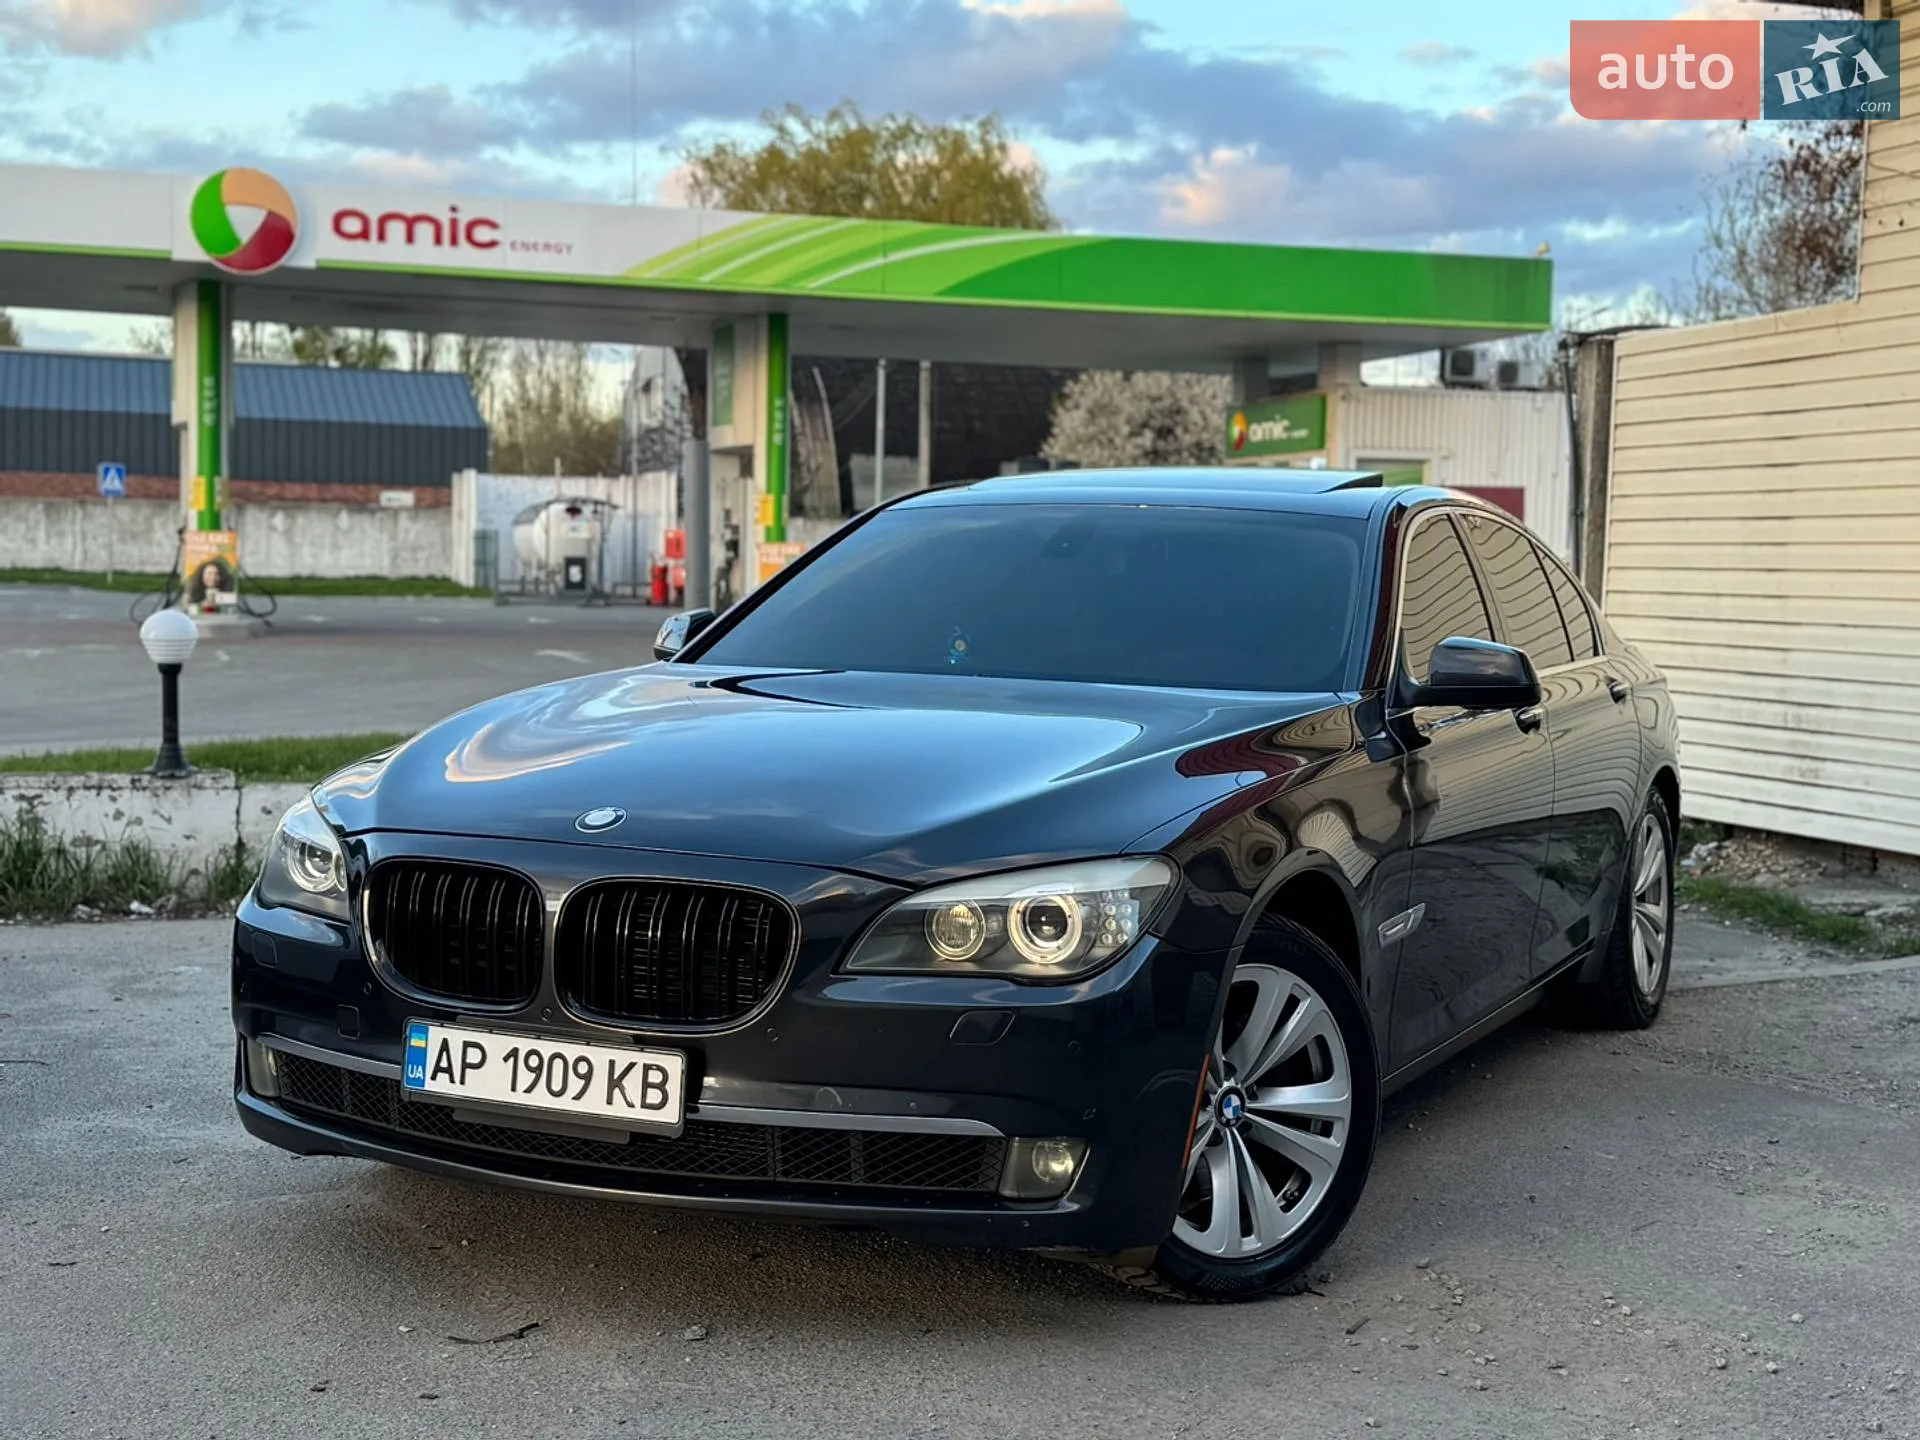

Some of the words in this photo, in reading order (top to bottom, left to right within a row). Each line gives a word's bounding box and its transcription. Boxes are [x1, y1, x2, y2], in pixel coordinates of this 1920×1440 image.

[331, 204, 502, 250] amic
[509, 239, 574, 256] ENERGY
[1249, 414, 1290, 442] amic
[407, 1064, 424, 1081] UA
[430, 1036, 488, 1086] AP
[502, 1046, 594, 1101] 1909
[605, 1058, 670, 1111] KB
